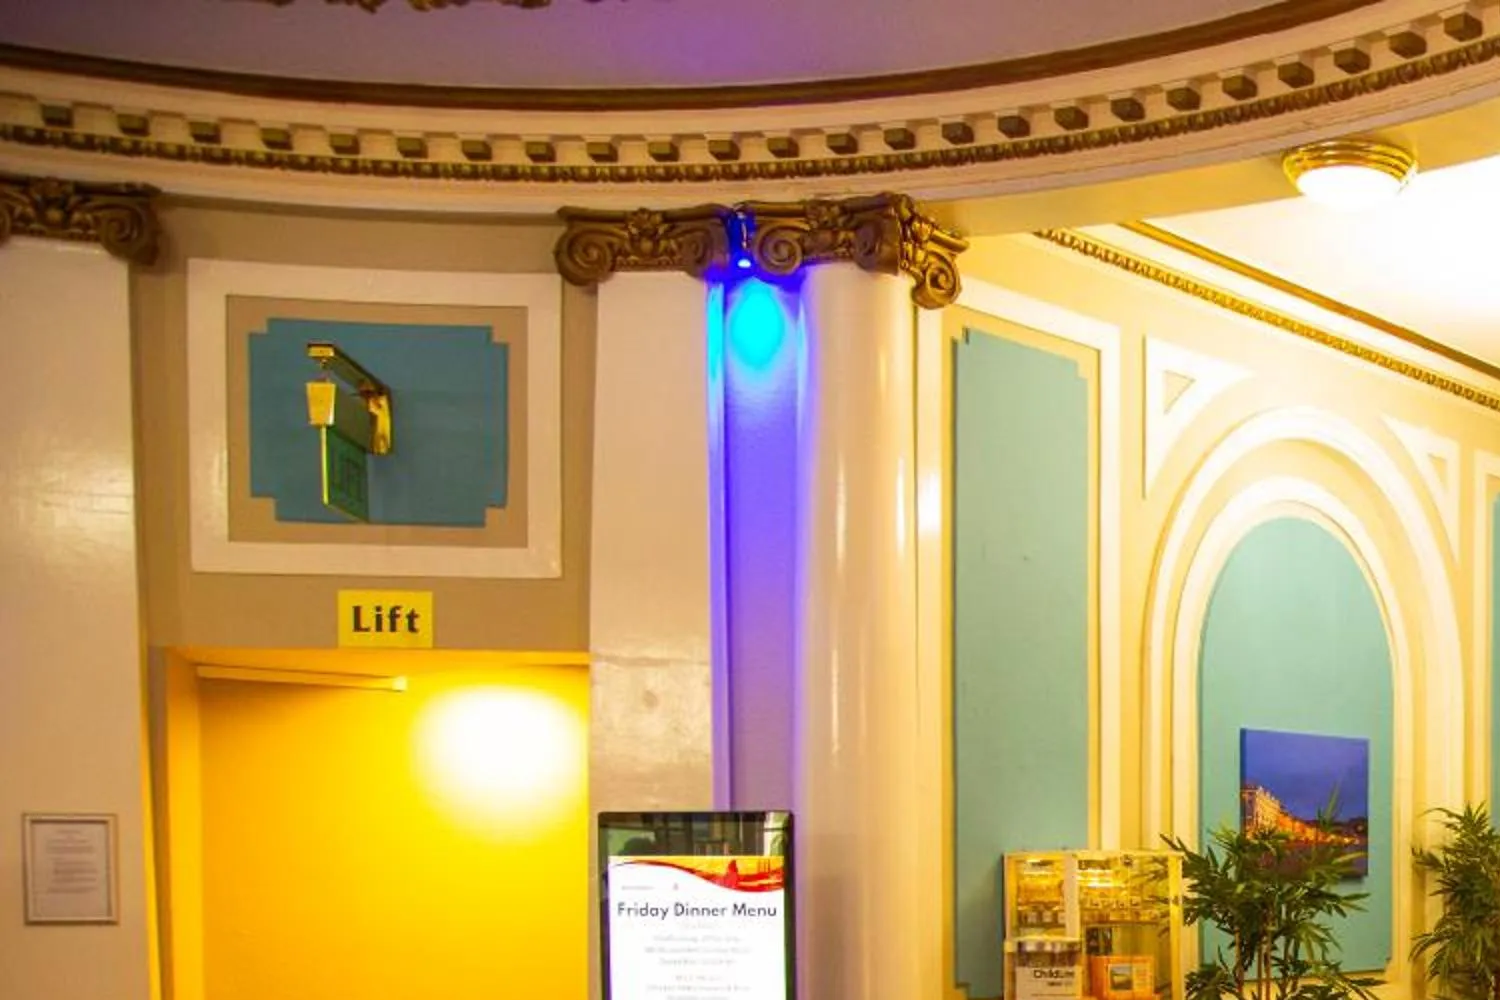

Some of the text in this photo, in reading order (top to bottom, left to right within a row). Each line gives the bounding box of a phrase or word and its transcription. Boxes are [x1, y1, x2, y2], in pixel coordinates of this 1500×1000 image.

[352, 605, 421, 633] Lift
[617, 902, 777, 920] Friday Dinner Menu
